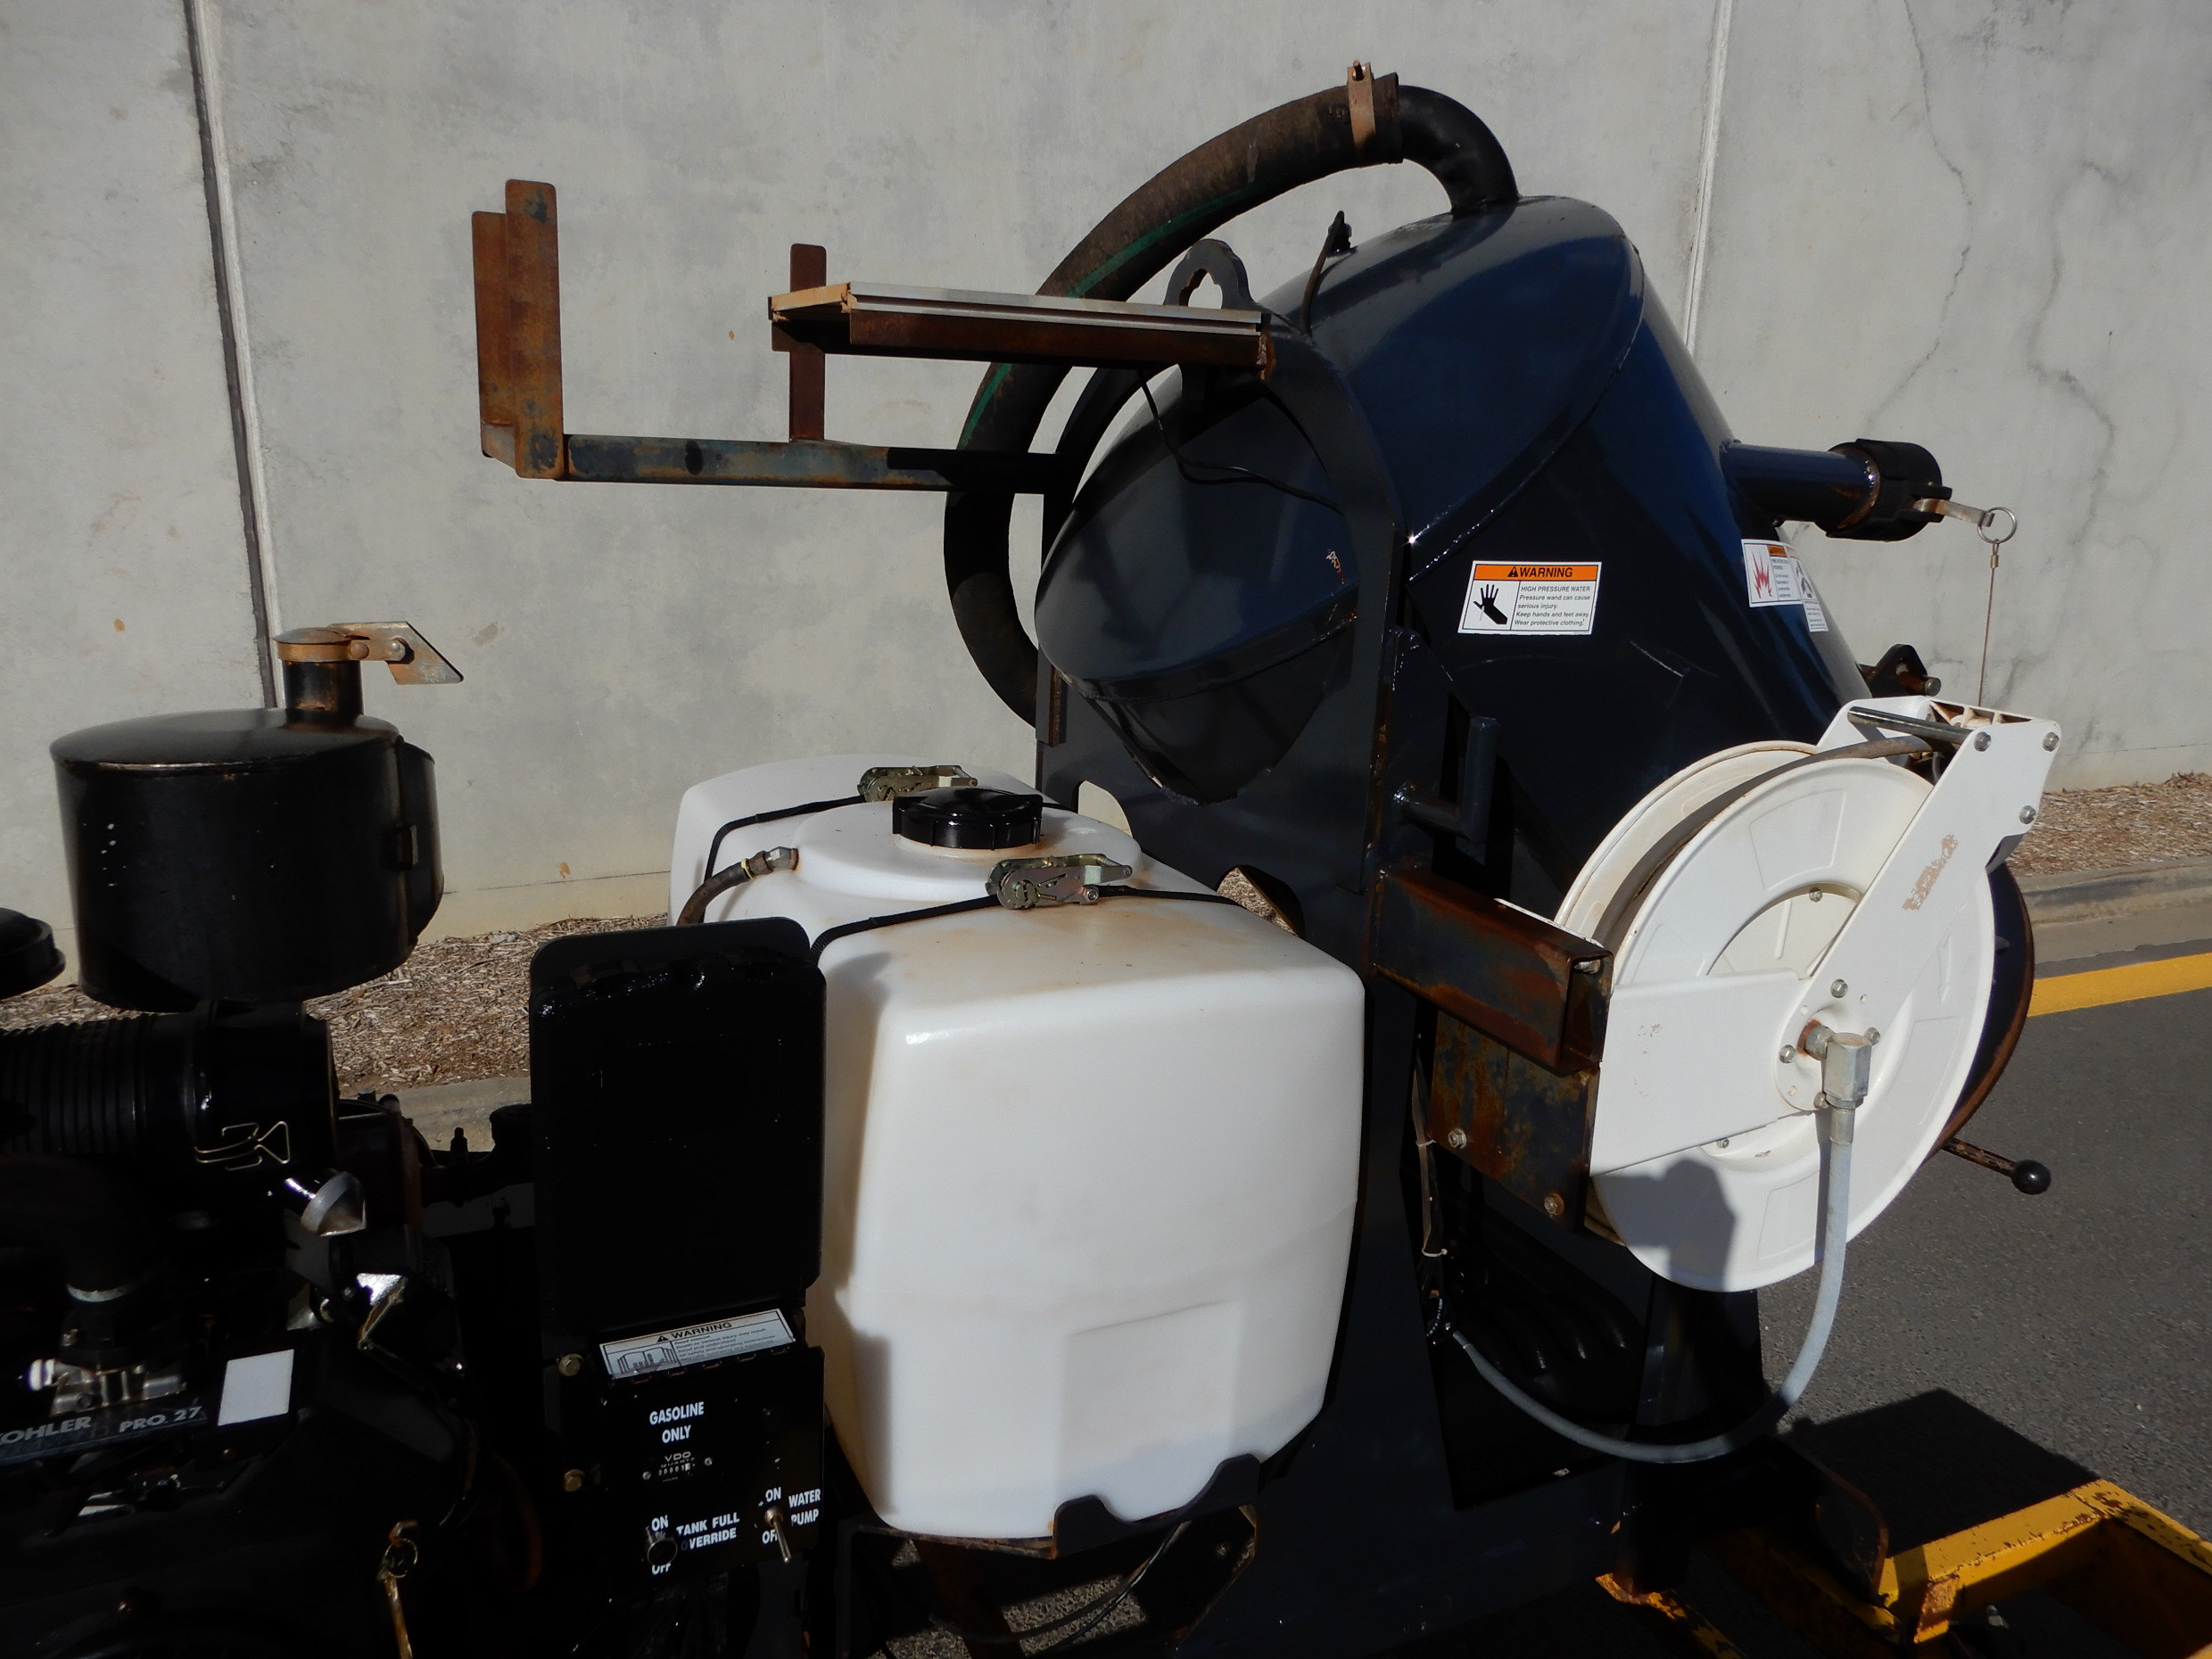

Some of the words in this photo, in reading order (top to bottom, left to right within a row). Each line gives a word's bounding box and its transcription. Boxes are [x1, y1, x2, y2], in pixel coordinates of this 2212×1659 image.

[1520, 567, 1573, 578] WARNING
[672, 1322, 732, 1339] WARNING
[649, 1401, 705, 1425] GASOLINE
[0, 1416, 92, 1445] OHLER
[174, 1406, 202, 1422] 27
[662, 1424, 692, 1444] ONLY
[664, 1450, 691, 1462] VDO
[764, 1487, 782, 1503] ON
[788, 1488, 821, 1508] WATER
[651, 1514, 669, 1531] ON
[676, 1519, 708, 1536] TANK
[712, 1512, 740, 1529] FULL
[790, 1507, 820, 1527] PUMP
